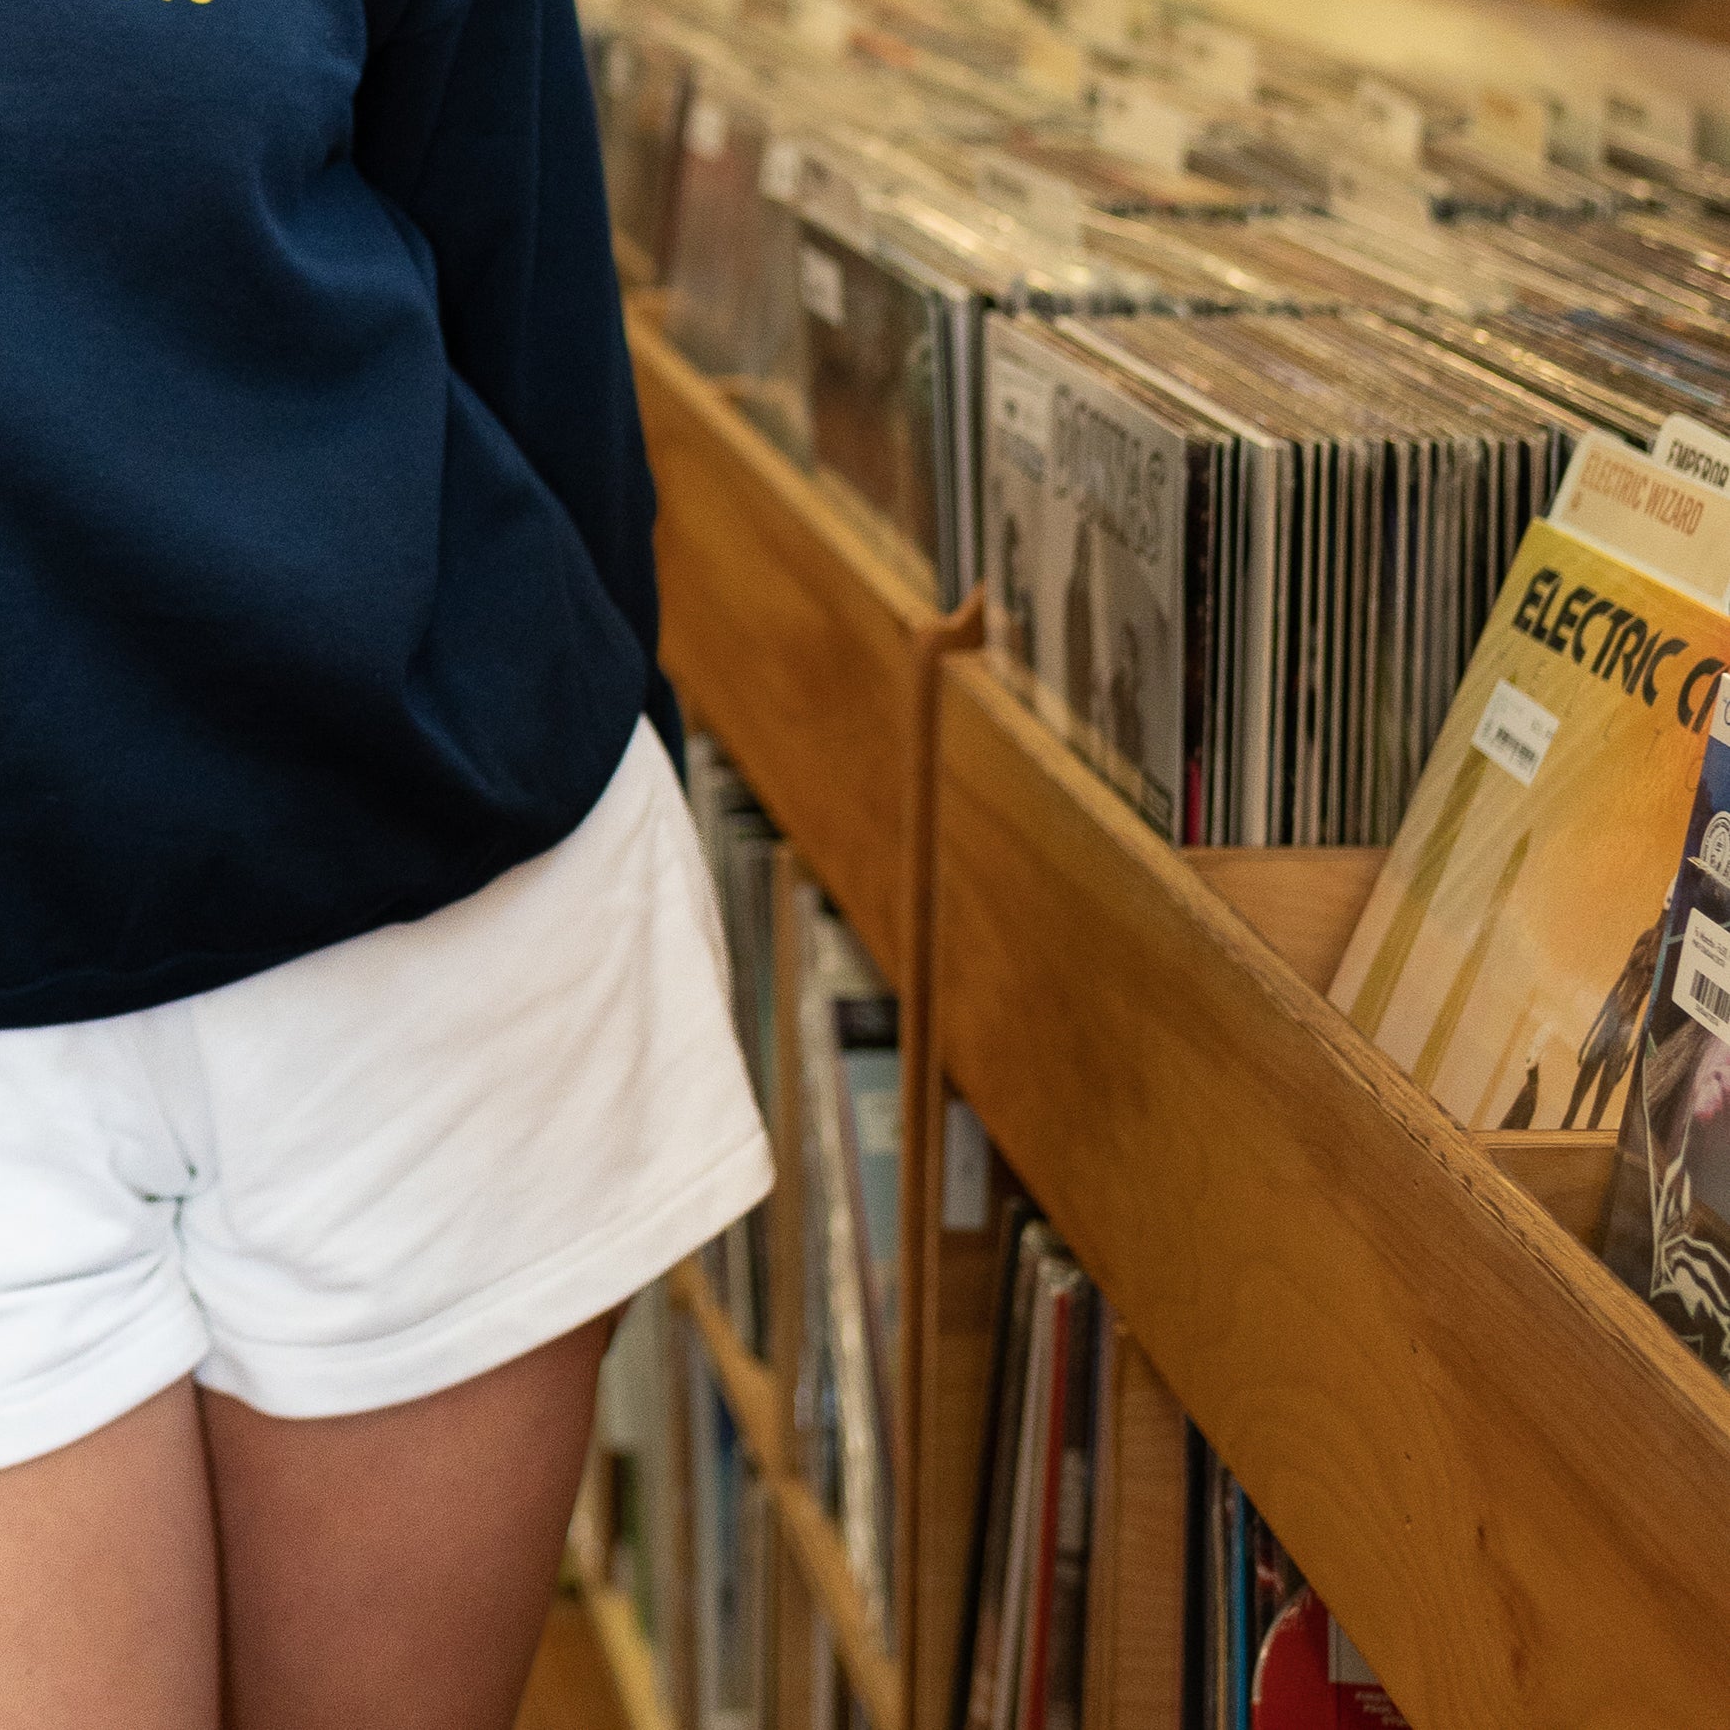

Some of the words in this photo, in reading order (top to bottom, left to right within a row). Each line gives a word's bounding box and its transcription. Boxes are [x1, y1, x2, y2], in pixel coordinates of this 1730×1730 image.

[1579, 446, 1649, 510] ELECTRIC
[1644, 481, 1705, 536] WIZARD
[1511, 566, 1688, 707] ELECTRIC
